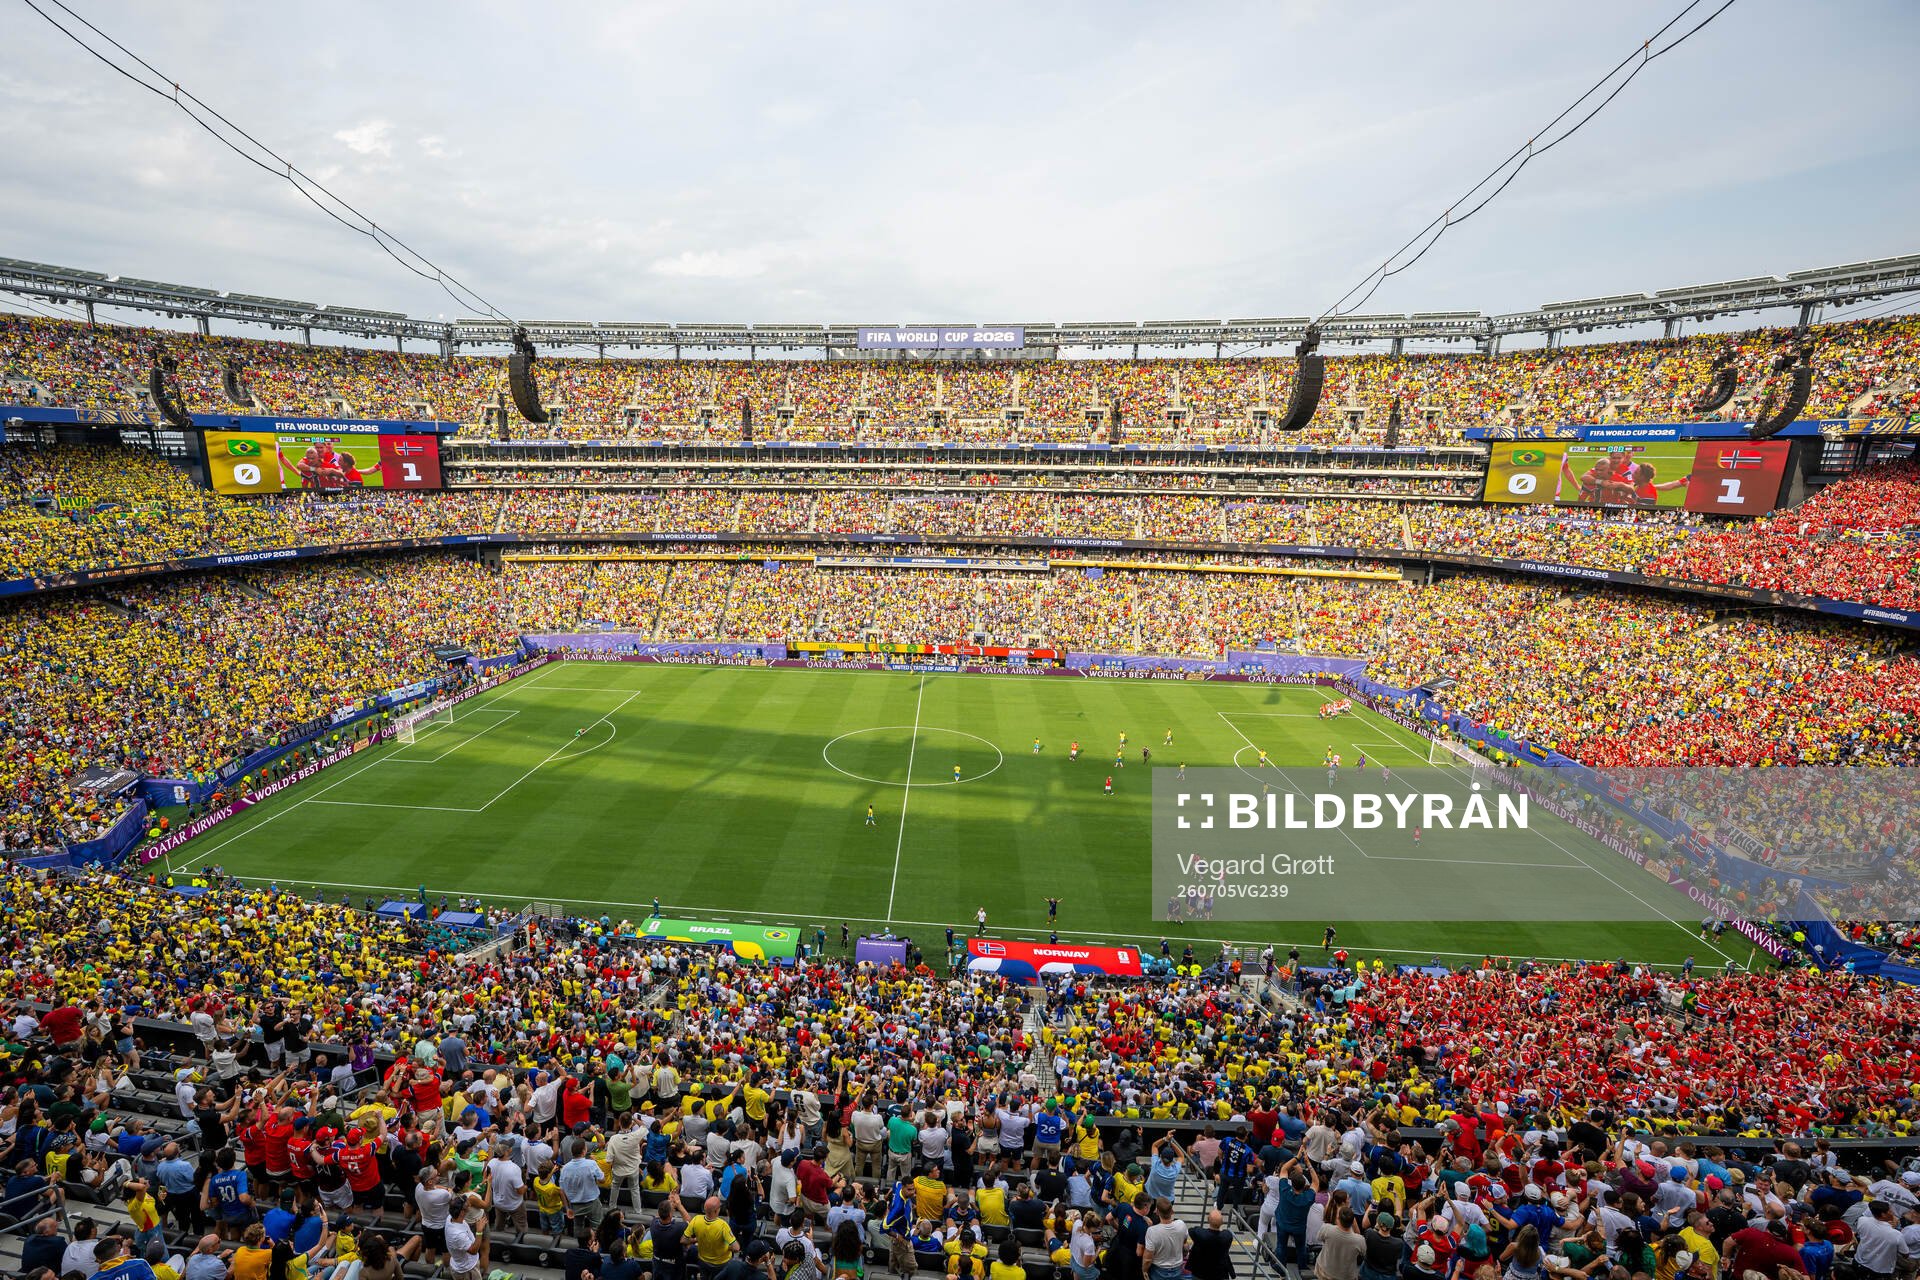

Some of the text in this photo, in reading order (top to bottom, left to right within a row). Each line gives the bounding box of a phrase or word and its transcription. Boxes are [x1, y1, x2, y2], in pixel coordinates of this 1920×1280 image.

[867, 332, 1015, 342] FIFA WORLD CUP 2026
[275, 422, 296, 430] FIFA
[297, 423, 331, 431] WORLD
[402, 463, 422, 481] 1
[1716, 479, 1745, 504] 1
[217, 556, 234, 564] FIFA
[234, 554, 259, 562] WORLD
[1537, 565, 1564, 573] WORLD
[1582, 569, 1609, 578] 2026
[514, 656, 548, 676] QATAR AIRWAYS
[661, 656, 696, 664] WORLD'S
[718, 658, 749, 666] AIRLINE
[806, 661, 833, 669] QATAR
[1010, 667, 1045, 675] AIRWAYS
[1089, 670, 1185, 680] WORLD'S BEST AIRLINE
[1248, 675, 1316, 684] QATAR AIRWAYS
[440, 692, 464, 710] WORLD'S
[465, 688, 478, 699] BEST
[478, 678, 498, 692] AIRLINE
[1378, 706, 1402, 724] WORLD'S
[1402, 719, 1417, 732] BEST
[381, 721, 404, 738] QATAR
[255, 746, 353, 801] WORLD'S BEST AIRLINE
[148, 805, 233, 859] QATAR AIRWAYS
[1535, 793, 1644, 866] WORLD'S BEST AIRLINE
[1688, 886, 1729, 918] QATAR
[689, 926, 733, 935] BRAZIL
[1033, 948, 1090, 958] NORWAY
[1041, 1124, 1057, 1135] 26
